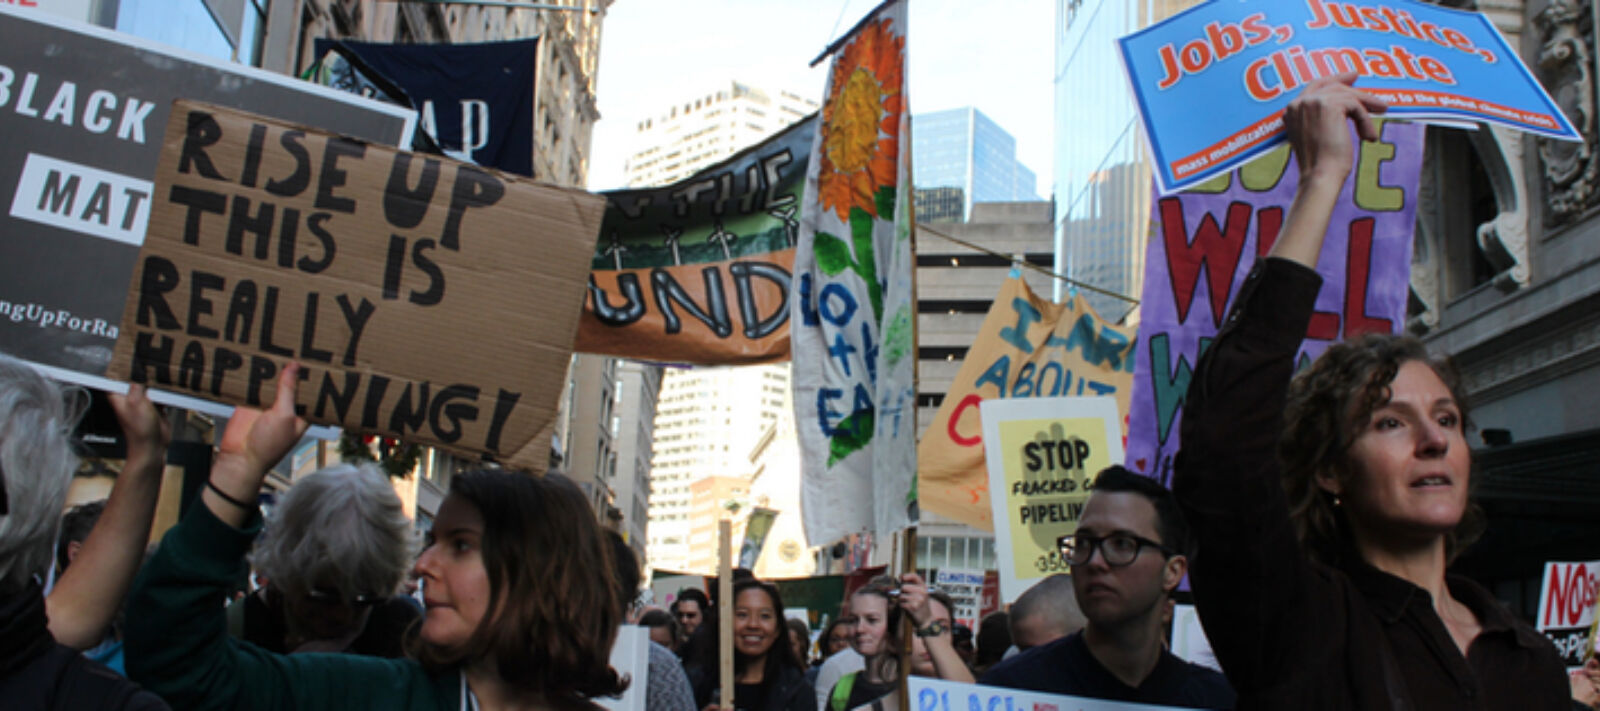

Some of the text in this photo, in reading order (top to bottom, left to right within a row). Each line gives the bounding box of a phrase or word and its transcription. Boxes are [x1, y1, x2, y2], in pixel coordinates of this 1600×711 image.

[1158, 0, 1499, 91] Jobs, Justice,
[1244, 45, 1457, 101] Climate
[0, 65, 156, 144] BLACK
[1175, 155, 1210, 176] mass
[1209, 113, 1287, 161] mobilization
[1399, 92, 1413, 103] to
[1414, 92, 1437, 104] the
[1438, 96, 1477, 111] global
[37, 169, 149, 232] MAT
[178, 111, 506, 252] RISE UP
[169, 185, 446, 306] THIS IS
[1158, 196, 1393, 340] WL
[136, 255, 376, 366] REALLY
[998, 297, 1042, 354] I
[1012, 478, 1077, 497] FRACKED
[1024, 440, 1091, 472] STOP
[1544, 563, 1587, 626] NO
